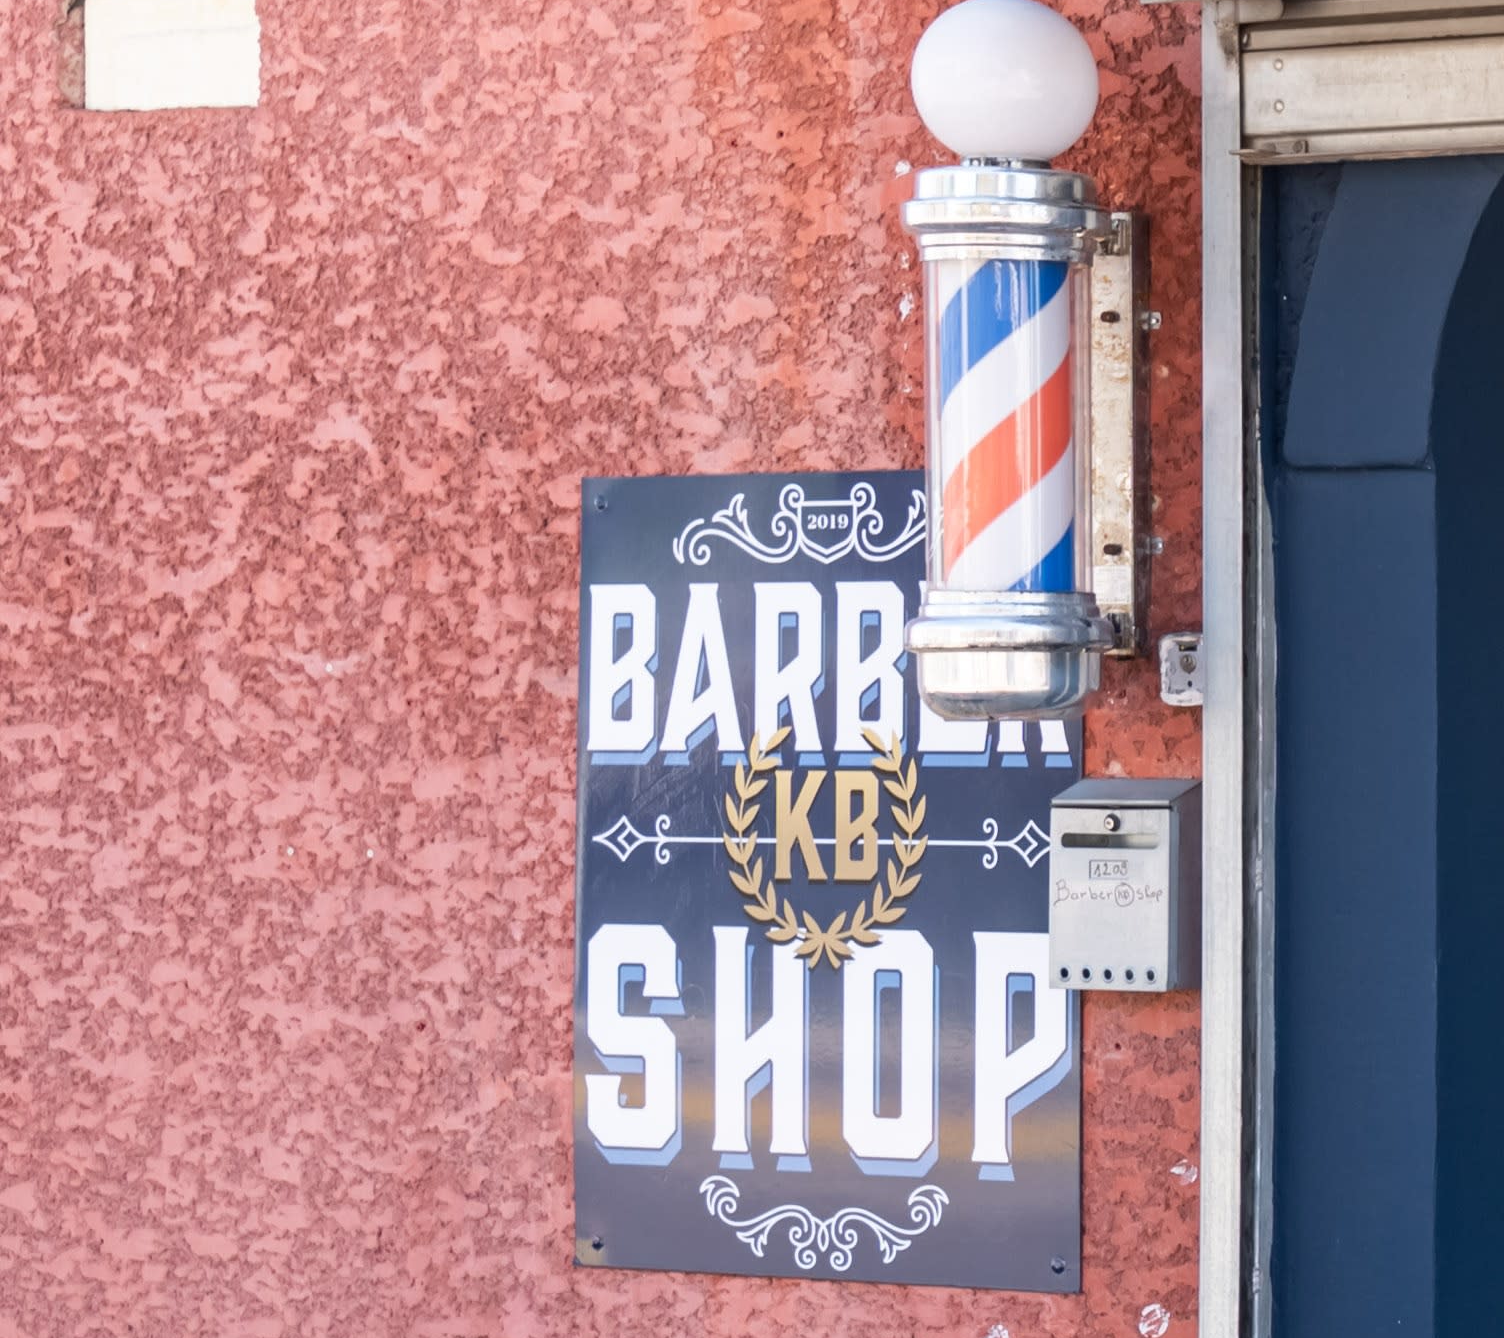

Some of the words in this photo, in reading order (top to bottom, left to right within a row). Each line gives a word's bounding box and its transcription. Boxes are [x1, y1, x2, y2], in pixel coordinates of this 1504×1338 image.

[806, 513, 850, 532] 2019
[587, 581, 1070, 759] BARB
[774, 768, 880, 883] KB
[584, 922, 1070, 1164] SHOP
